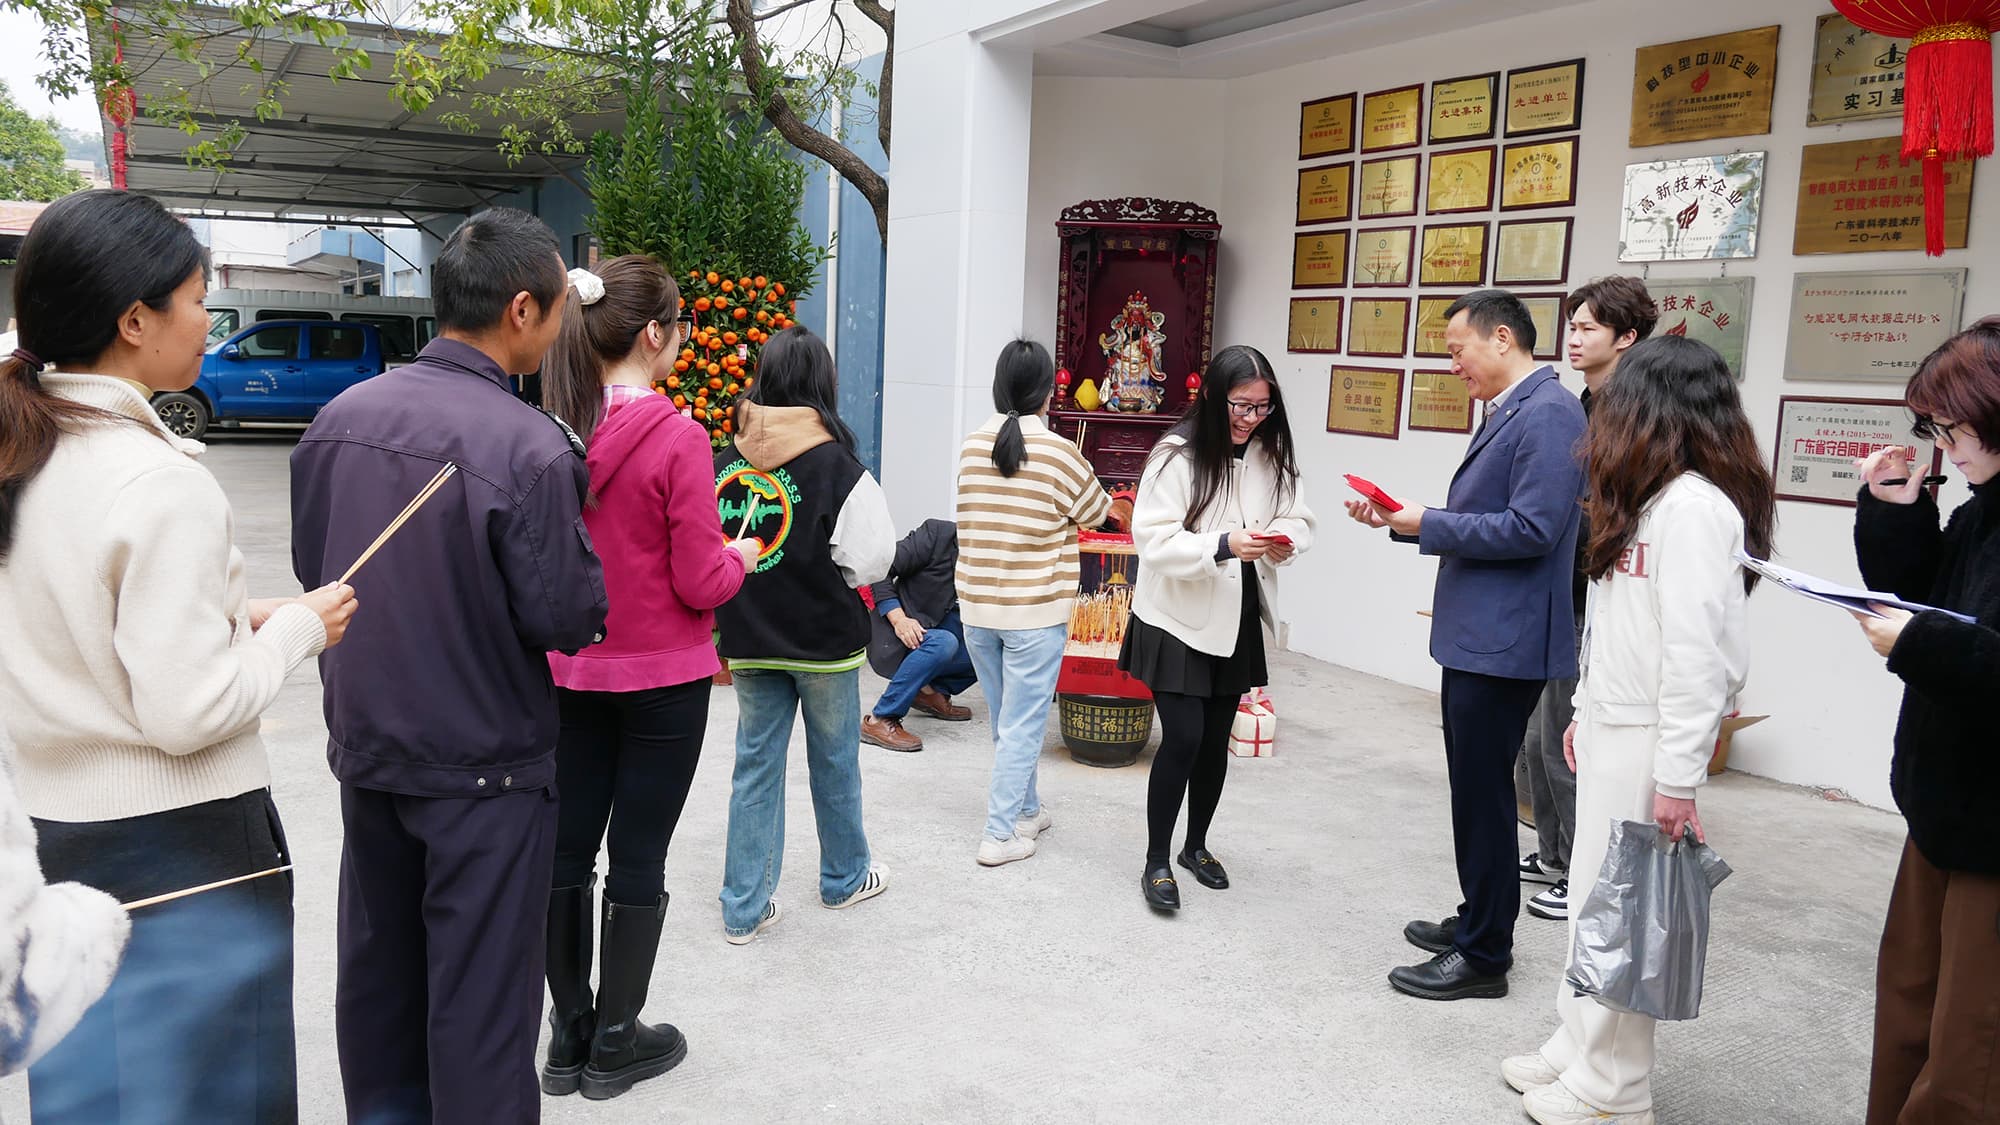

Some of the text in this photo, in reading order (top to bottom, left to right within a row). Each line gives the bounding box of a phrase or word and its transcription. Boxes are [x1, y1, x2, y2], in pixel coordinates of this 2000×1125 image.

[1645, 51, 1760, 92] 科技型中小企业
[1513, 91, 1569, 108] 先进单位
[1439, 104, 1484, 119] 先进集体
[1637, 174, 1743, 215] 高新技术企业
[1832, 194, 1924, 212] 工程技术研究中心
[1834, 216, 1921, 231] 广东省科学技术厅
[1653, 295, 1730, 331] 技术企业
[1344, 393, 1382, 407] 会员单位
[1793, 438, 1917, 463] 广东省守合同重信业
[1071, 713, 1085, 729] 福
[1101, 717, 1118, 733] 福
